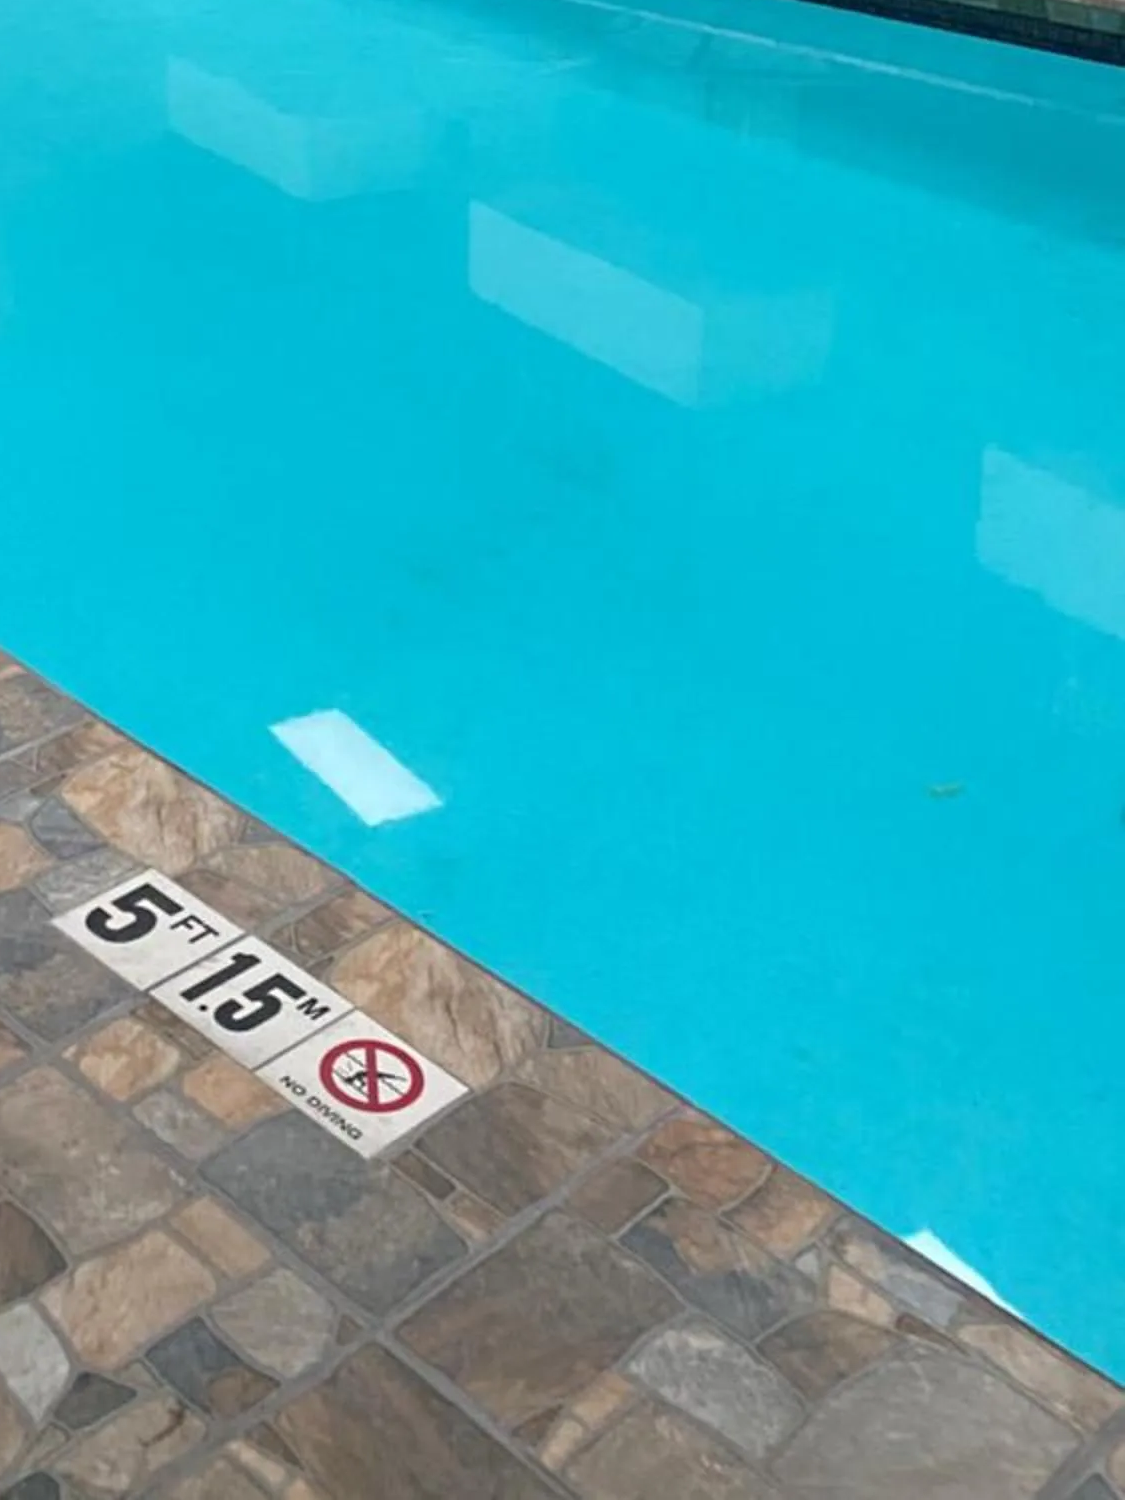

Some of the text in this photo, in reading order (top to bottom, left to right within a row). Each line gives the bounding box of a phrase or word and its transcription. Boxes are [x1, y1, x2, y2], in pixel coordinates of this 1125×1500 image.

[84, 883, 219, 945] 5 FT
[180, 952, 331, 1033] 1.5 M
[279, 1075, 363, 1141] NO DIVING
